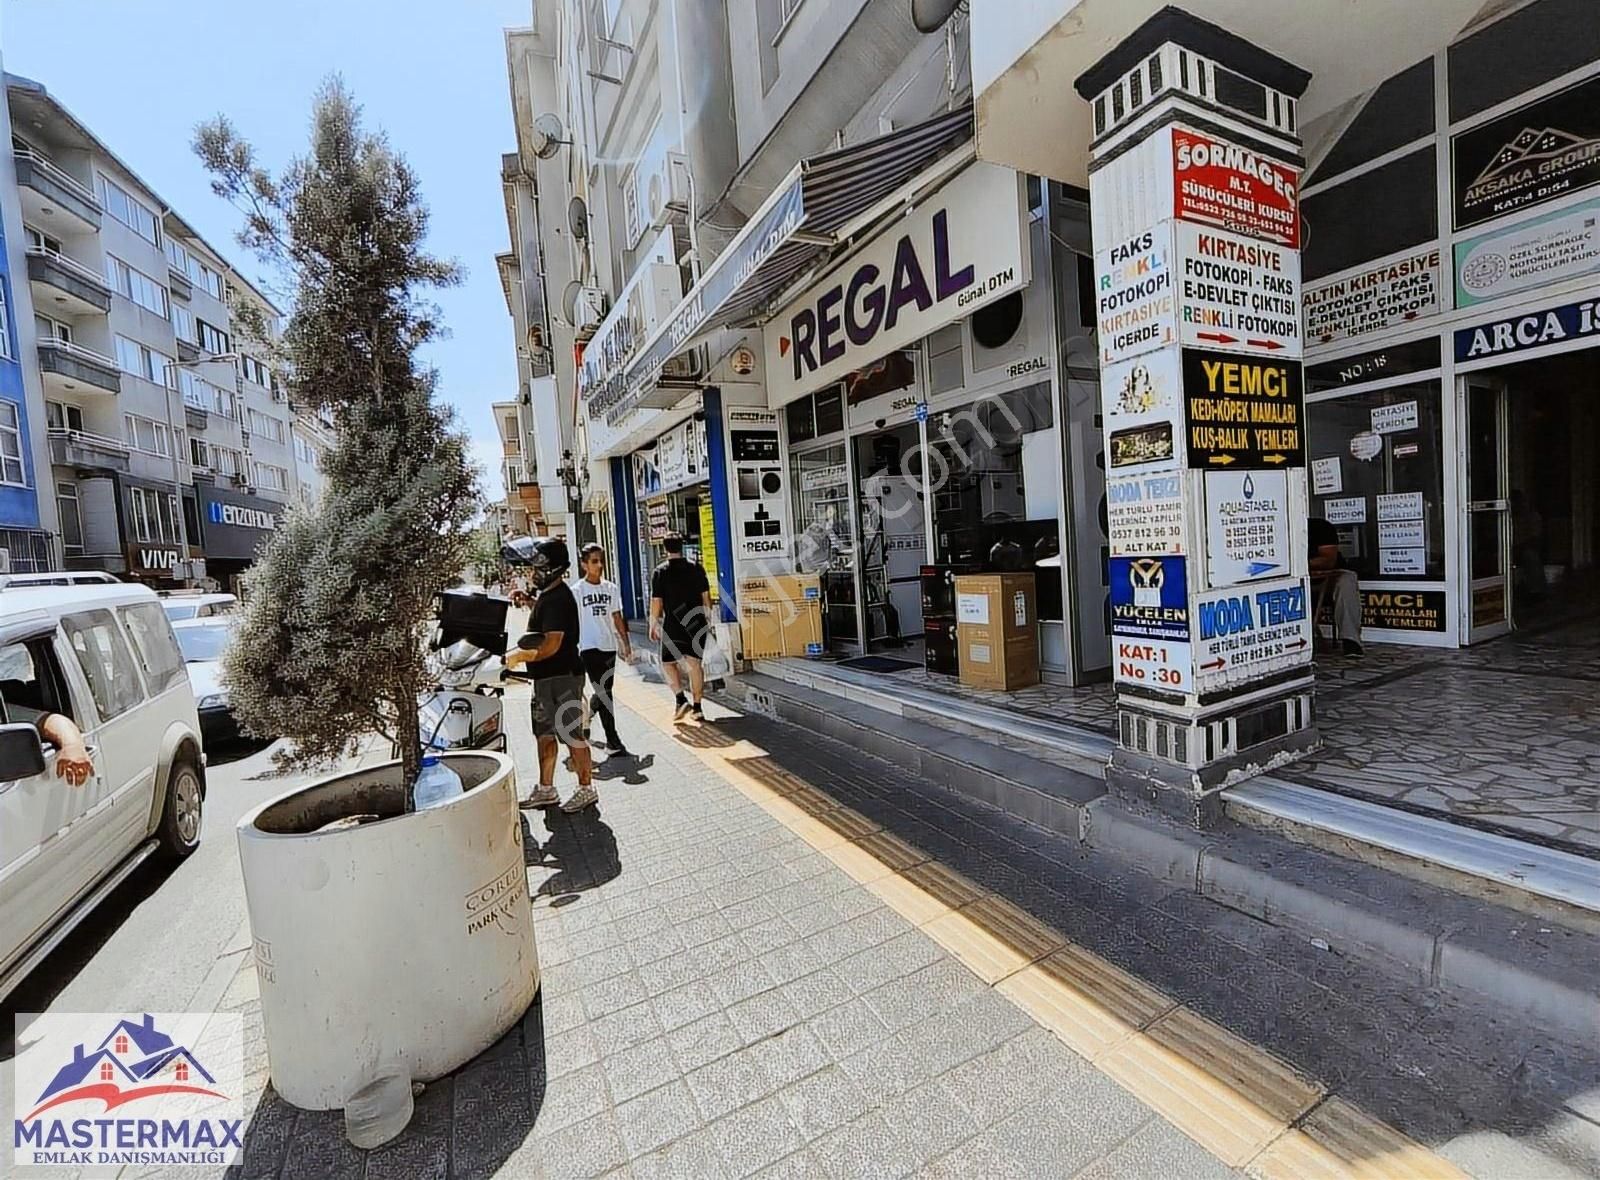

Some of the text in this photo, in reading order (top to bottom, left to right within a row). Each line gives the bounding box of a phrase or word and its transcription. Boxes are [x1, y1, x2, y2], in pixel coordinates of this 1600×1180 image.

[1177, 143, 1296, 211] SORMAGEÇ
[1229, 175, 1252, 194] M.T.
[1464, 169, 1533, 201] AKSAKA
[1182, 179, 1294, 224] SÜRÜCÜLERİ KURSU
[1110, 232, 1153, 265] FAKS
[1198, 234, 1281, 271] KIRTASİYE
[791, 208, 975, 380] REGAL
[957, 268, 1014, 307] Günal DTM
[1100, 267, 1170, 313] FOTOKOPİ
[1185, 258, 1253, 288] FOTOKOPİ
[1263, 276, 1293, 296] FAKS
[1303, 252, 1440, 306] ALTIN KIRTASİYE
[1309, 287, 1378, 316] FOTOKOPİ
[1391, 273, 1430, 292] FAKS
[1101, 295, 1171, 335] KIRTASİYE
[1184, 281, 1296, 316] E-DEVLET ÇIKTISI
[1307, 294, 1436, 339] RENKLİ FOTOKOPİ
[1309, 283, 1433, 327] E-DEVLET ÇIKTISI
[1113, 324, 1160, 350] İÇERDE
[1183, 305, 1298, 339] RENKLİ FOTOKOPİ
[1467, 312, 1566, 356] ARCA
[1008, 357, 1047, 377] REGAL
[1340, 365, 1362, 382] NO
[1250, 401, 1296, 424] MAMALARI
[1192, 426, 1298, 452] KUŞ-BALIK YEMLERİ
[745, 540, 784, 553] REGAL
[1124, 542, 1168, 552] ALT KAT
[1114, 603, 1187, 621] YÜCELEN
[1199, 595, 1255, 641] MODA
